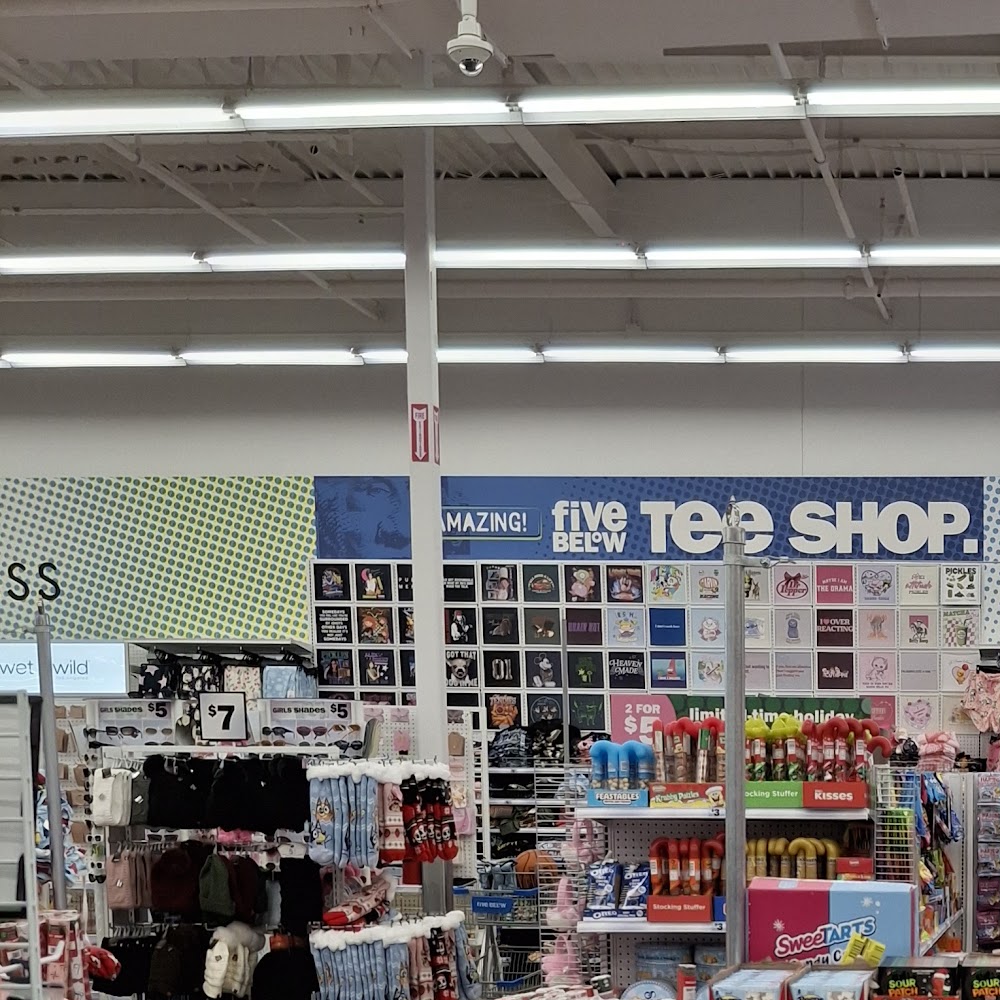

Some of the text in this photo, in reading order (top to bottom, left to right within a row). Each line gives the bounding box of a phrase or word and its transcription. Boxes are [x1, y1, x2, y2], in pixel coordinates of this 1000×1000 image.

[788, 500, 979, 554] SHOP.
[552, 531, 627, 553] BELOW
[945, 567, 977, 576] PICKLES
[817, 585, 830, 593] THE
[830, 618, 851, 626] OVER
[446, 651, 477, 659] GOT THAT
[0, 660, 89, 675] wet wild
[147, 702, 168, 717] $5
[330, 703, 348, 718] $5
[624, 703, 661, 714] 2 FOR
[208, 703, 235, 731] $7
[595, 791, 640, 801] FEASTABLES
[654, 794, 678, 803] Krabby
[745, 790, 798, 799] ocking Stuffer
[652, 903, 682, 911] Stocking
[593, 910, 618, 919] OREO
[888, 978, 916, 989] SOUR
[972, 978, 1000, 989] SOUR
[888, 987, 918, 997] PATCH
